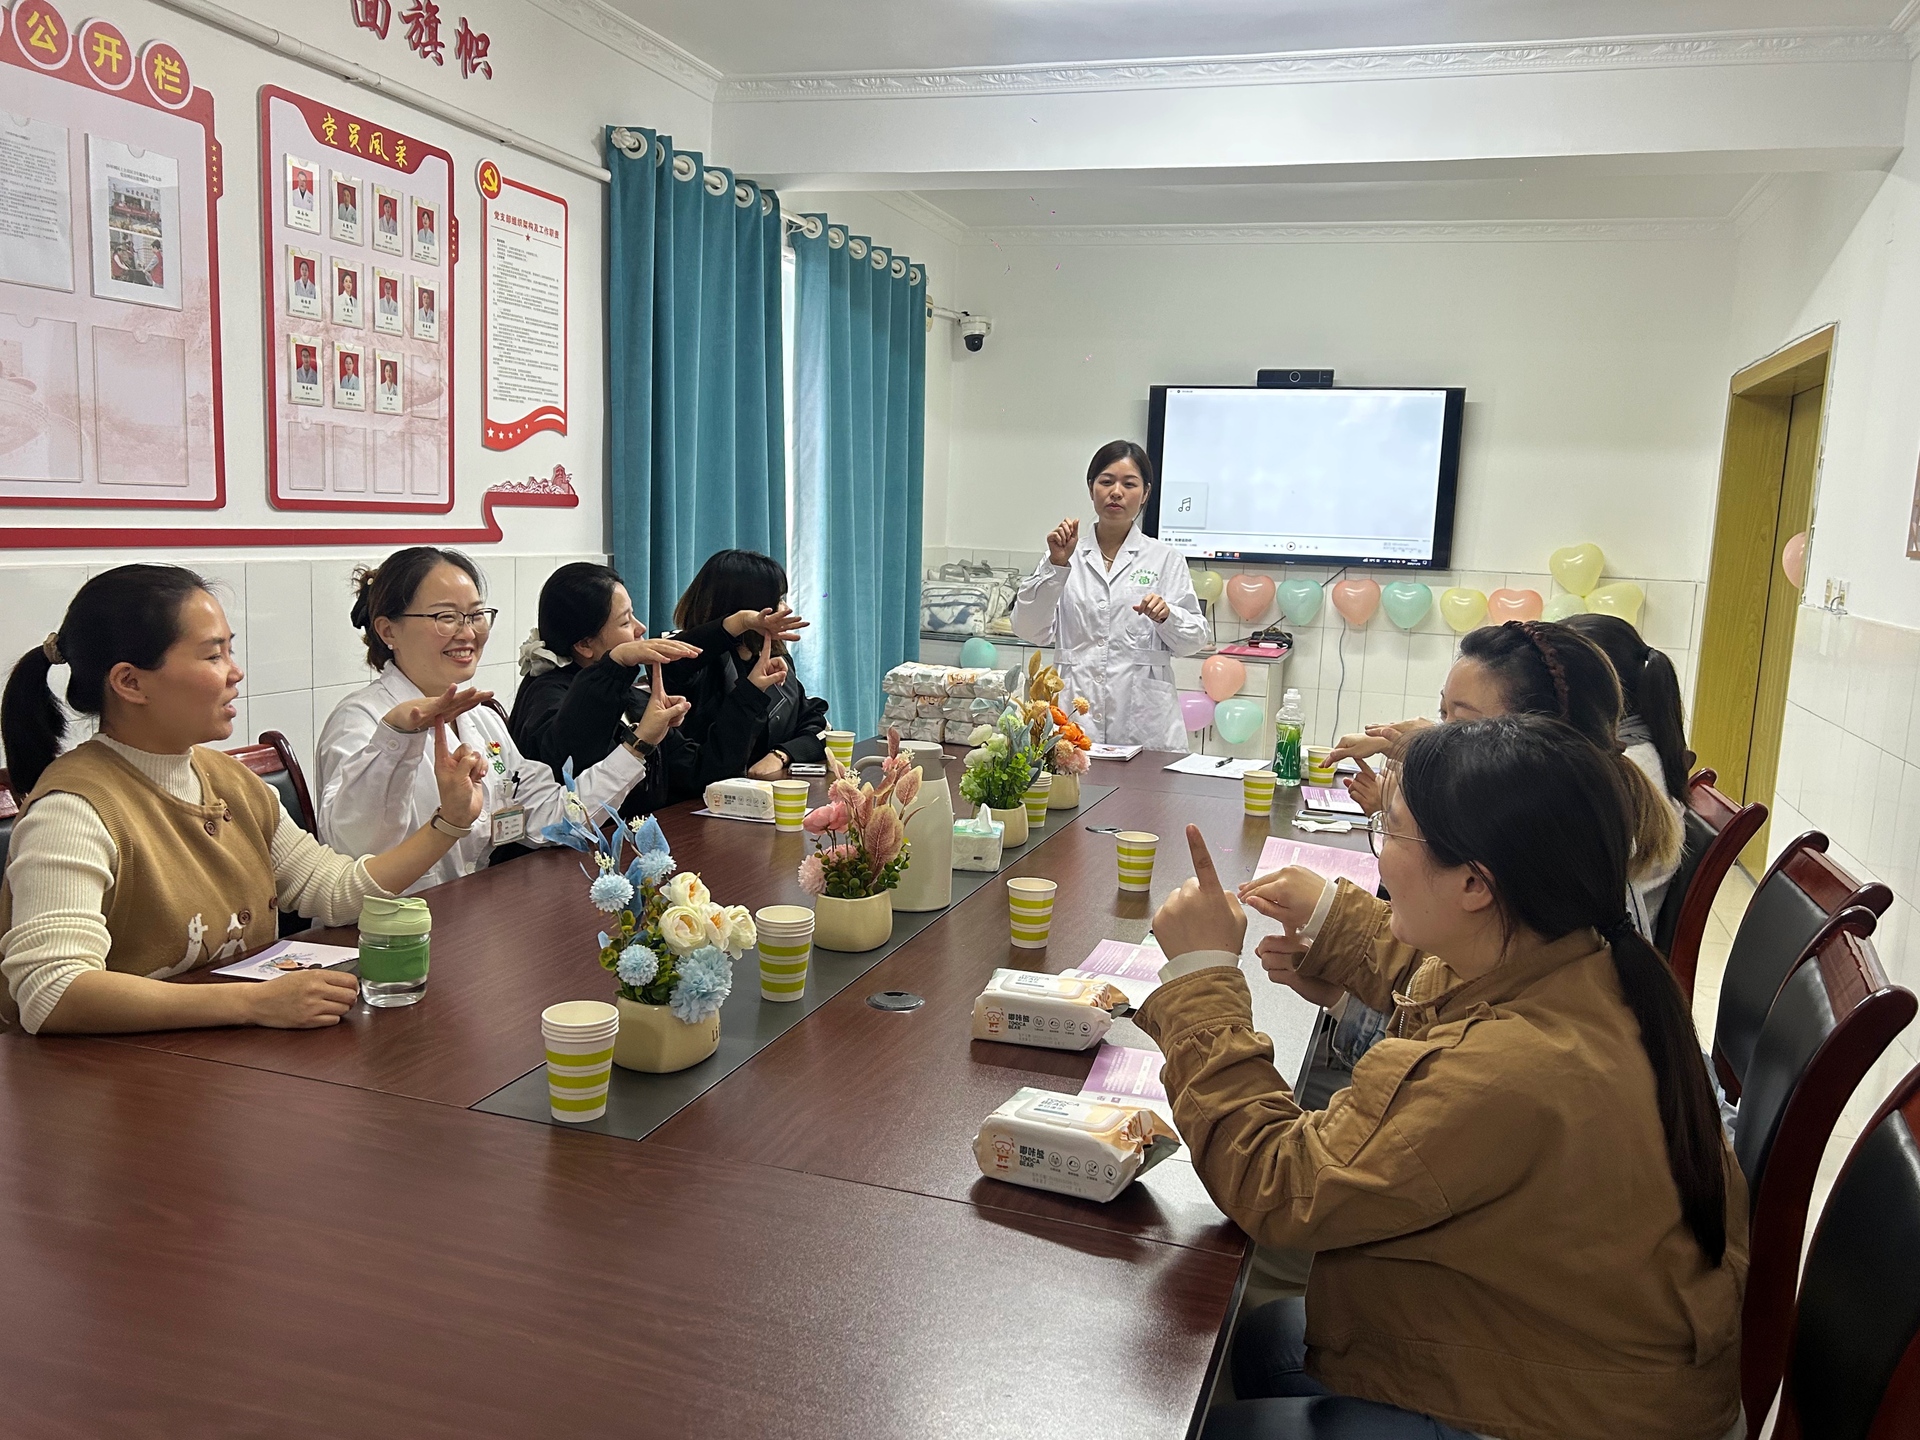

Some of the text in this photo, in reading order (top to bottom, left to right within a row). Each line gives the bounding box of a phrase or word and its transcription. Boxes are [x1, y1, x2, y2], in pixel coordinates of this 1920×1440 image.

[26, 10, 182, 95] 公开栏
[493, 210, 560, 240] 党支部组织架构及工作职责
